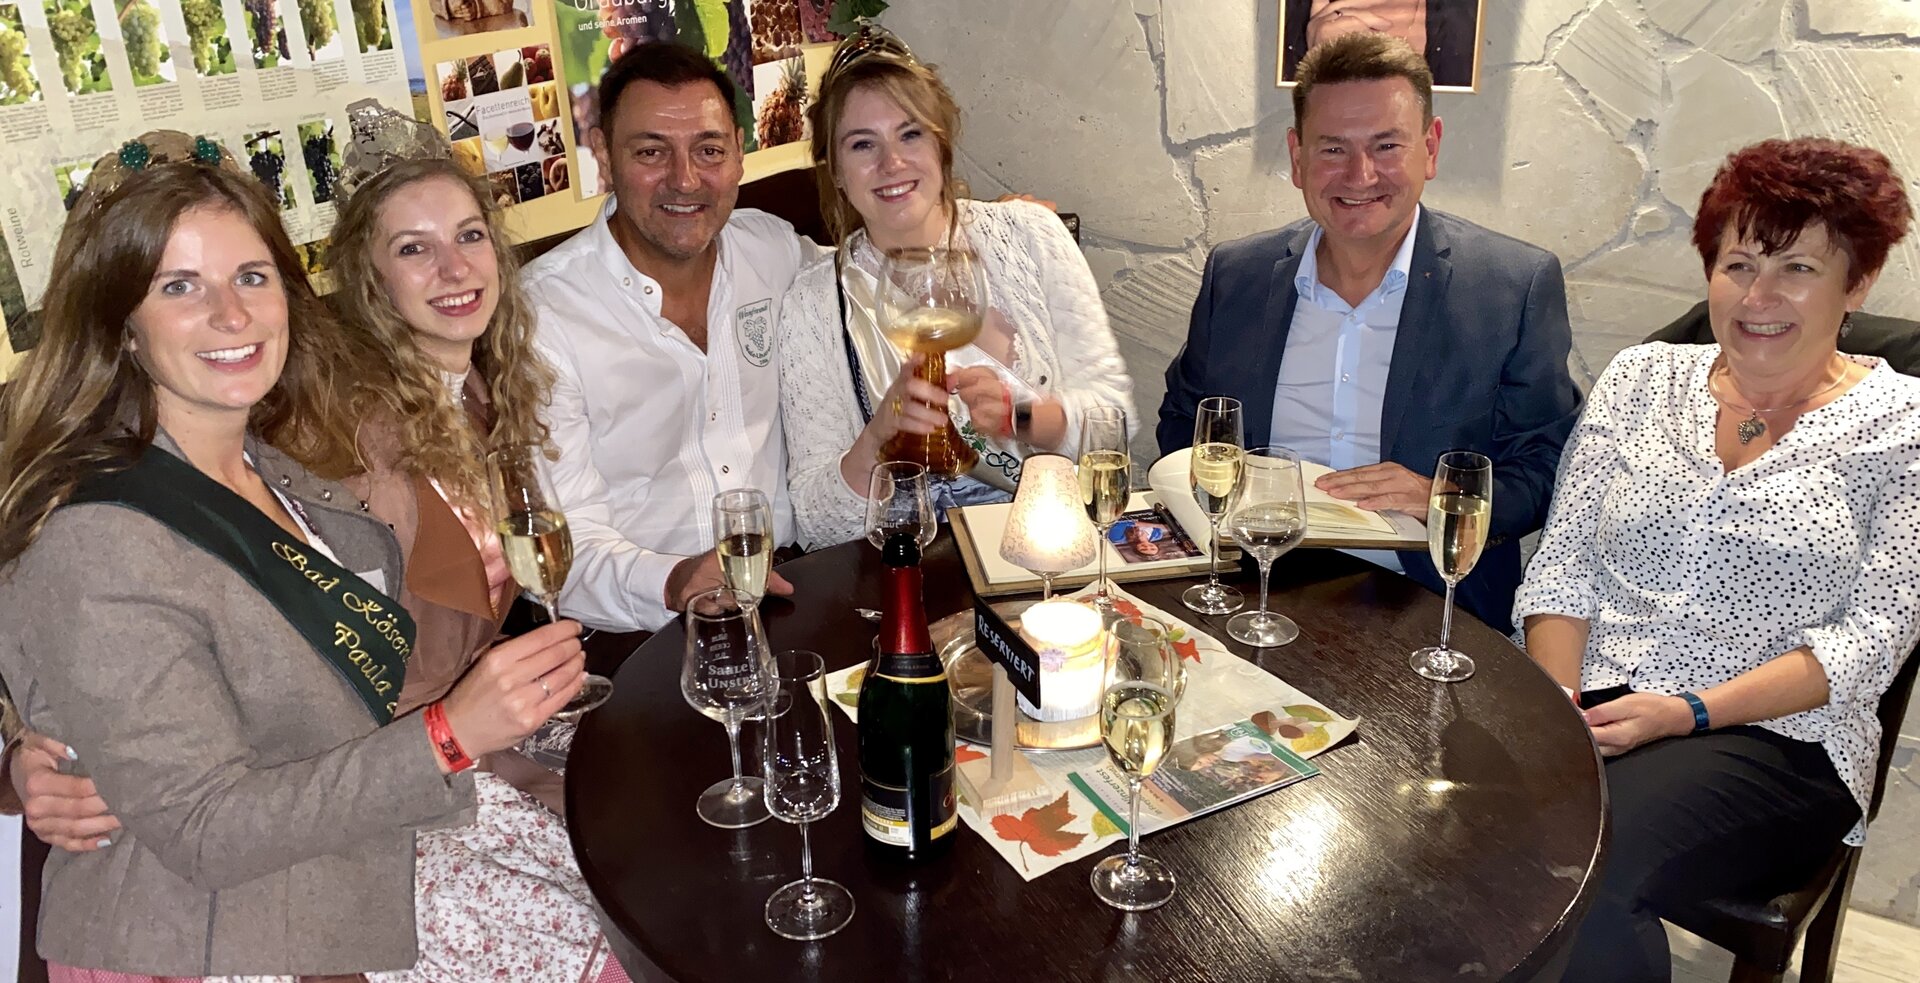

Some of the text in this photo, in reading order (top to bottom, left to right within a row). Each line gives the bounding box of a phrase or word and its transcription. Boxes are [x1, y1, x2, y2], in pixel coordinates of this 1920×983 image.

[578, 15, 648, 31] und seine Aromen
[475, 96, 530, 116] Facettenreich
[7, 207, 34, 269] Rotweine
[271, 541, 340, 594] Bad
[334, 621, 393, 697] Paula
[978, 614, 1036, 682] RESERVIERT
